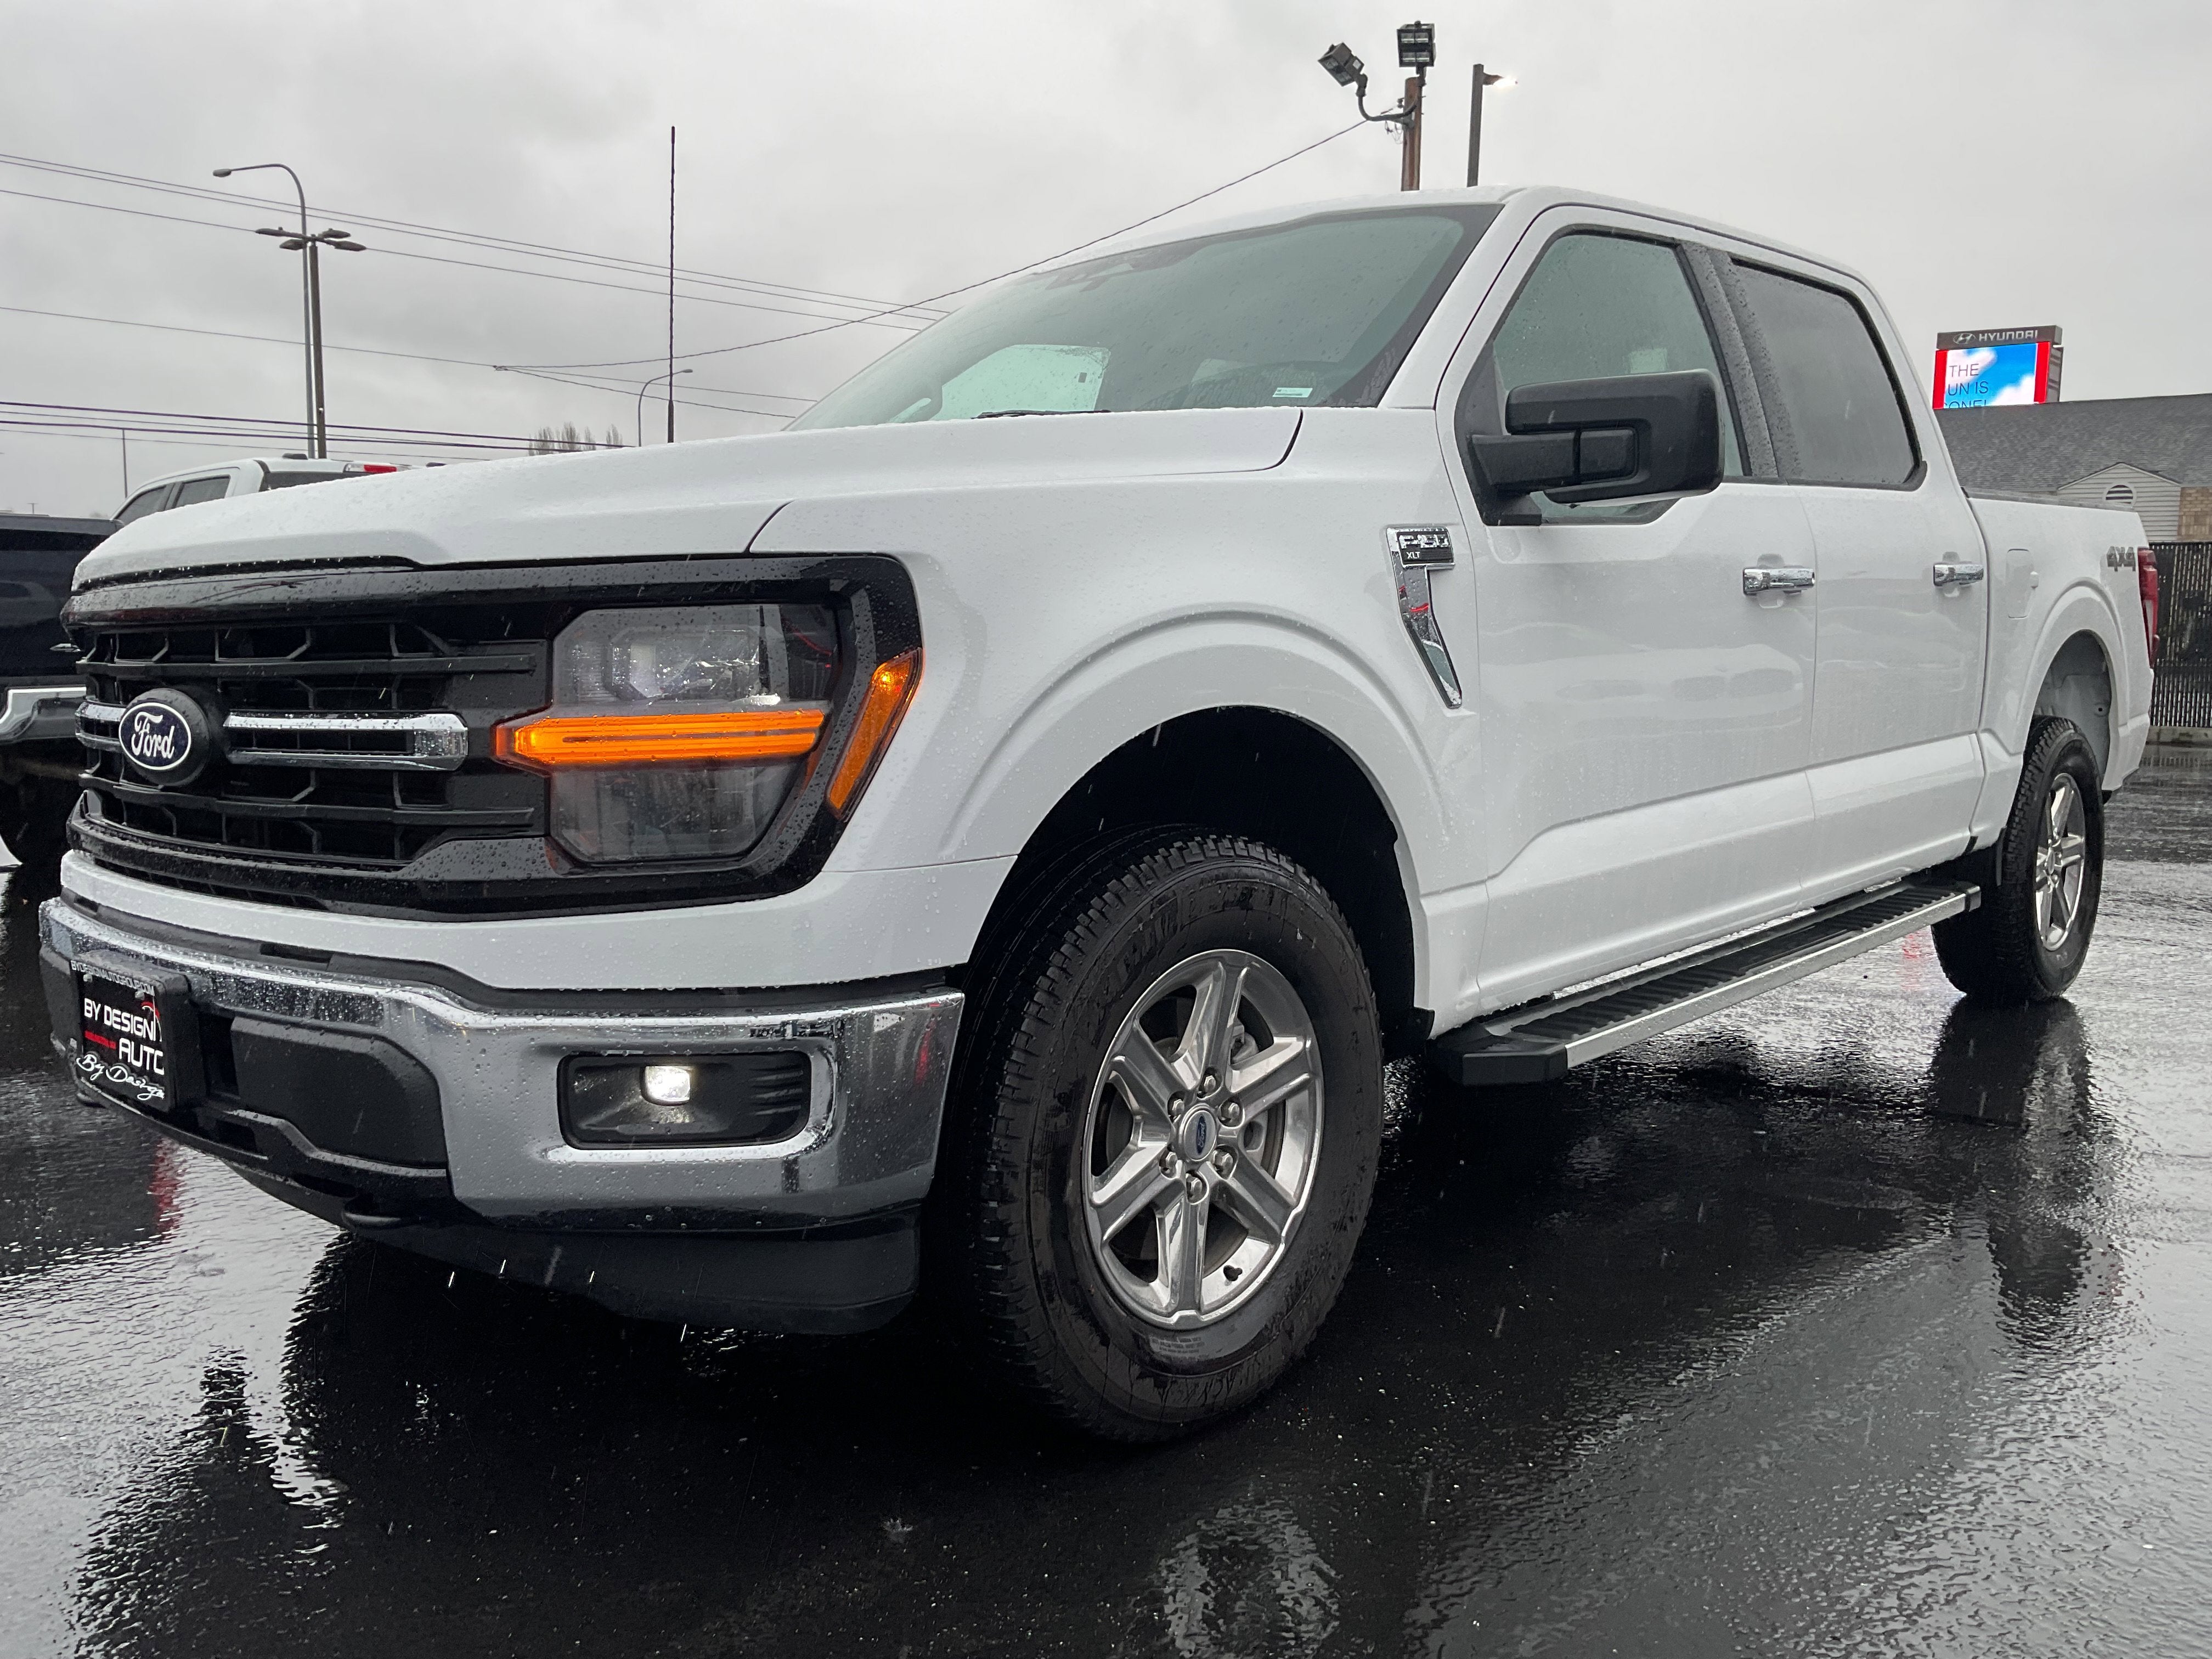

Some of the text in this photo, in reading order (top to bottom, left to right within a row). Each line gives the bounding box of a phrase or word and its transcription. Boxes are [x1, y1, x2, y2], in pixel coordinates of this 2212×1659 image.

[1979, 330, 2038, 341] HYUNDAI
[1949, 363, 1979, 377] THE
[1976, 381, 1989, 394] IS
[131, 712, 175, 758] Ford
[84, 998, 156, 1041] BY DESIGN
[76, 1053, 105, 1081] By
